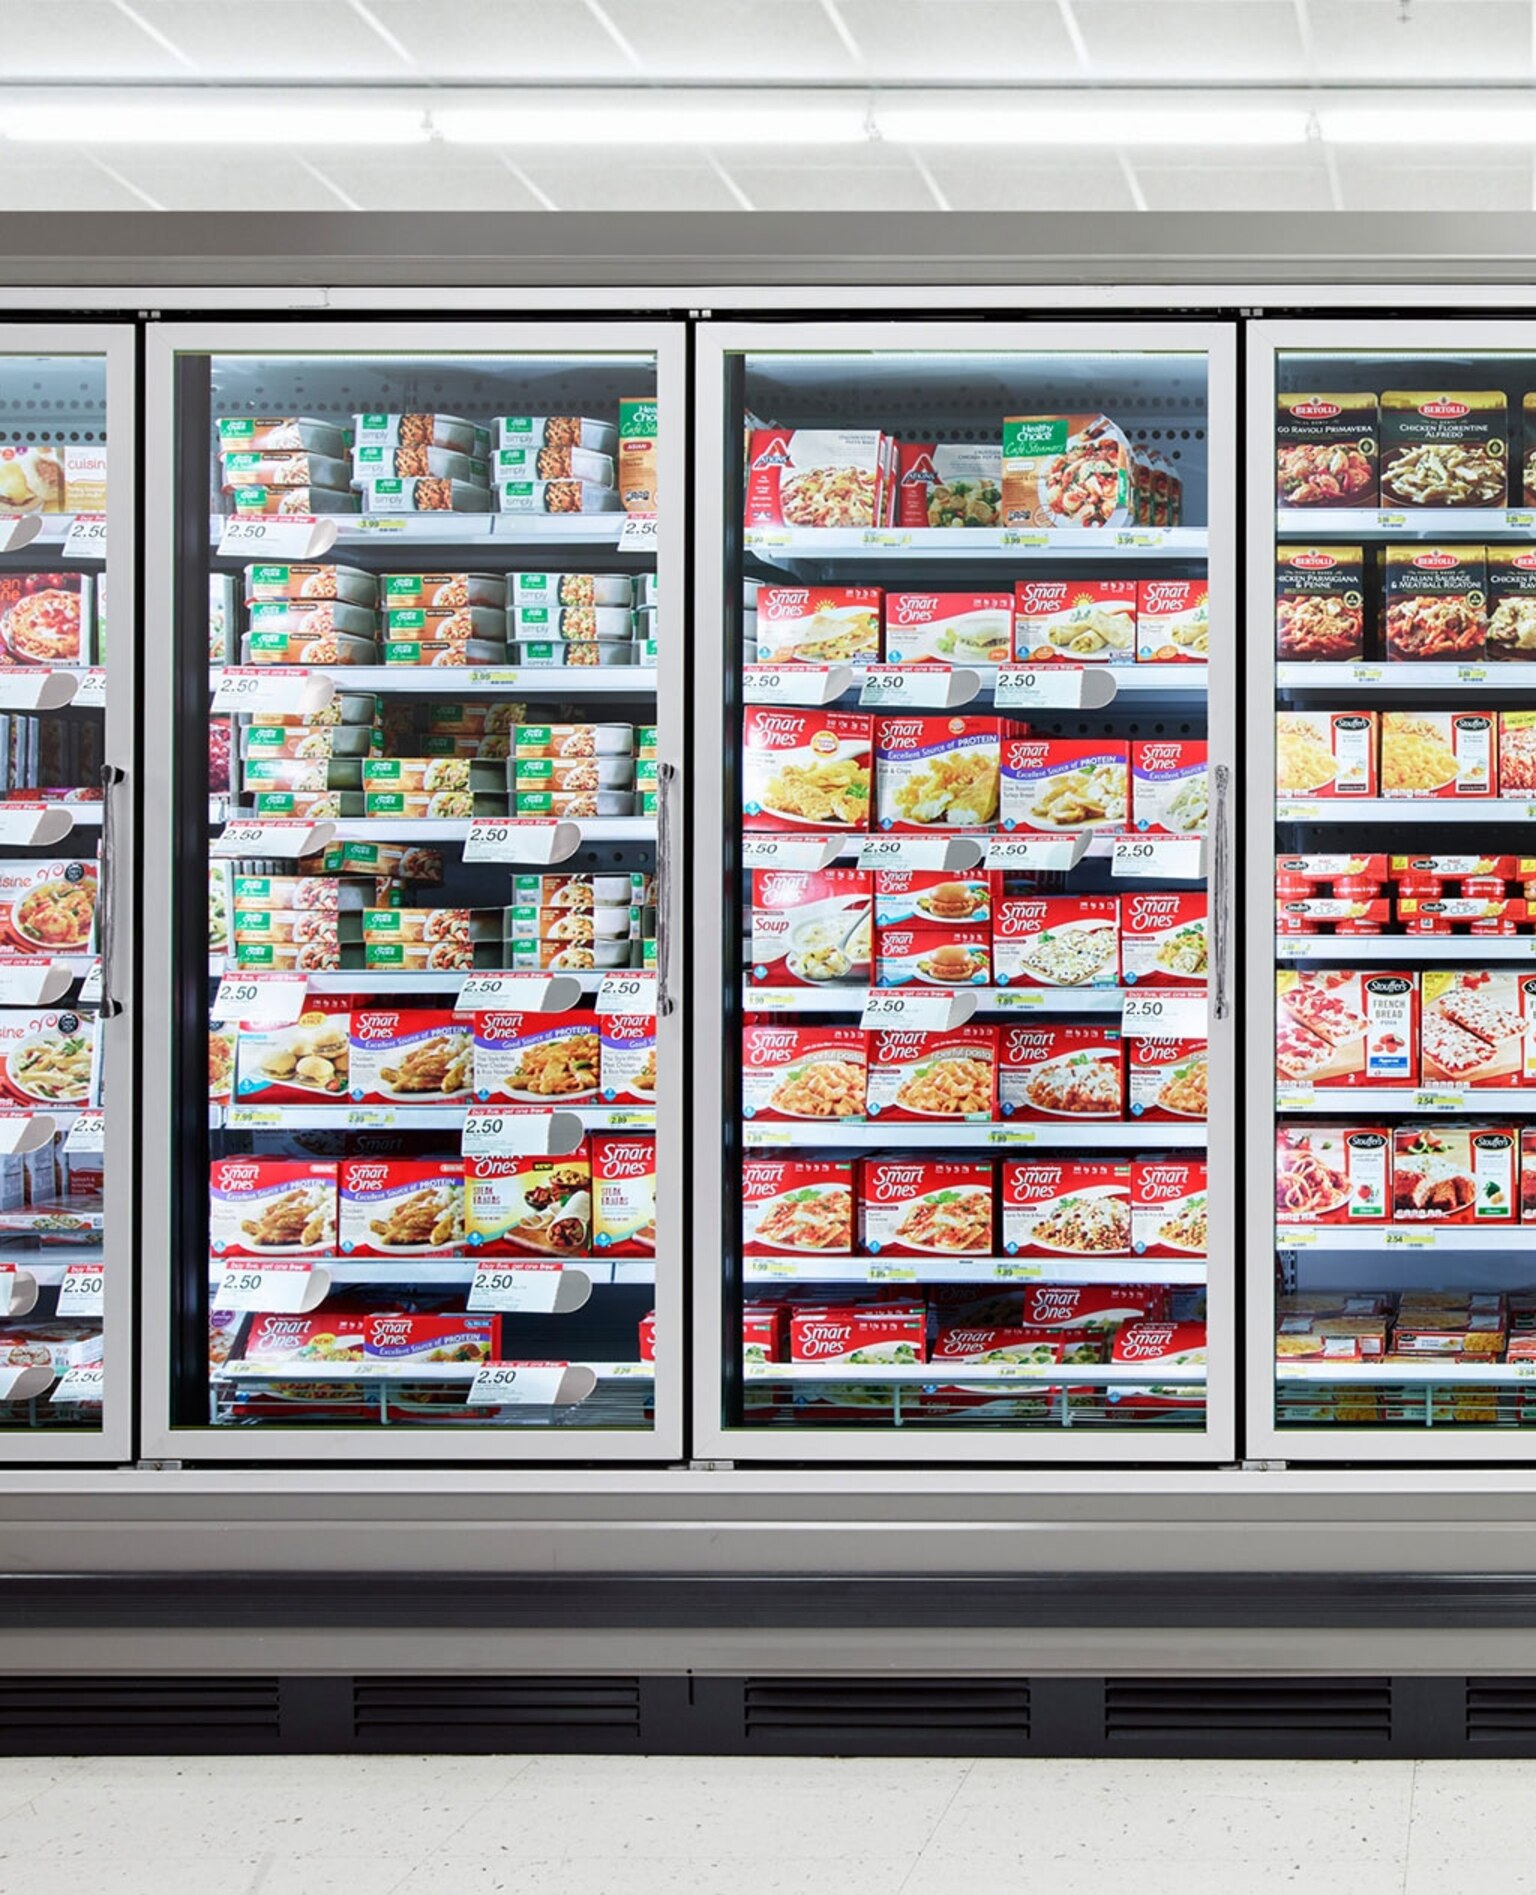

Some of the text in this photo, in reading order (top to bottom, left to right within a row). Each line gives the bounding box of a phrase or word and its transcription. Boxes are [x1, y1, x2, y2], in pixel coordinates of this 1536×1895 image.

[1022, 424, 1054, 434] Healthy
[1399, 424, 1488, 432] CHICKEN FLORENTINE
[1017, 432, 1053, 442] Choice
[67, 459, 106, 470] cuisin
[227, 525, 266, 538] 2.50
[1296, 557, 1332, 565] BERTOLLI
[1307, 575, 1358, 583] PARMIGIANA
[520, 591, 548, 603] simply
[765, 589, 810, 606] Smart
[1021, 584, 1068, 600] Smart
[1143, 584, 1190, 600] Smart
[896, 595, 938, 611] Smart
[768, 604, 804, 619] Ones
[221, 679, 259, 692] 2.50
[867, 676, 904, 688] 2.50
[751, 712, 806, 732] Smart
[878, 721, 924, 737] Smart
[1338, 719, 1369, 729] Stouffer's
[1458, 719, 1489, 729] Stouffer's
[756, 729, 797, 746] Ones
[1008, 743, 1050, 758] Smart
[1140, 744, 1182, 759] Smart
[224, 830, 263, 840] 2.50
[470, 828, 508, 841] 2.50
[998, 902, 1048, 920] Smart
[1129, 897, 1180, 915] Smart
[755, 918, 790, 934] Soup
[1002, 918, 1044, 934] Ones
[881, 932, 914, 945] Smart
[882, 943, 910, 955] Ones
[219, 986, 257, 1000] 2.50
[463, 981, 502, 992] 2.50
[1371, 981, 1408, 992] Stouffer's
[1373, 1000, 1406, 1009] FRENCH
[356, 1013, 399, 1030] Smart
[481, 1013, 524, 1028] Smart
[1375, 1010, 1403, 1019] BREAD
[747, 1031, 799, 1049] Smart
[1006, 1029, 1056, 1048] Smart
[1417, 1097, 1433, 1105] 2.54
[1352, 1136, 1383, 1147] Stouffer's
[1478, 1137, 1509, 1148] Stouffer's
[600, 1144, 653, 1163] Smart
[218, 1165, 260, 1180] Smart
[346, 1165, 389, 1180] Smart
[873, 1166, 925, 1185] Smart
[1011, 1166, 1063, 1186] Smart
[1138, 1166, 1189, 1186] Smart
[220, 1178, 255, 1191] Ones
[877, 1183, 918, 1200] Ones
[1014, 1184, 1057, 1200] Ones
[64, 1278, 102, 1293] 2.50
[475, 1275, 513, 1289] 2.50
[1032, 1289, 1081, 1306] Smart
[258, 1317, 312, 1334] Smart
[370, 1320, 413, 1335] Smart
[799, 1323, 851, 1341] Smart
[259, 1333, 303, 1350] Ones
[373, 1334, 408, 1347] Ones
[1121, 1331, 1173, 1346] Smart
[802, 1339, 846, 1356] Ones
[477, 1371, 516, 1383] 2.50
